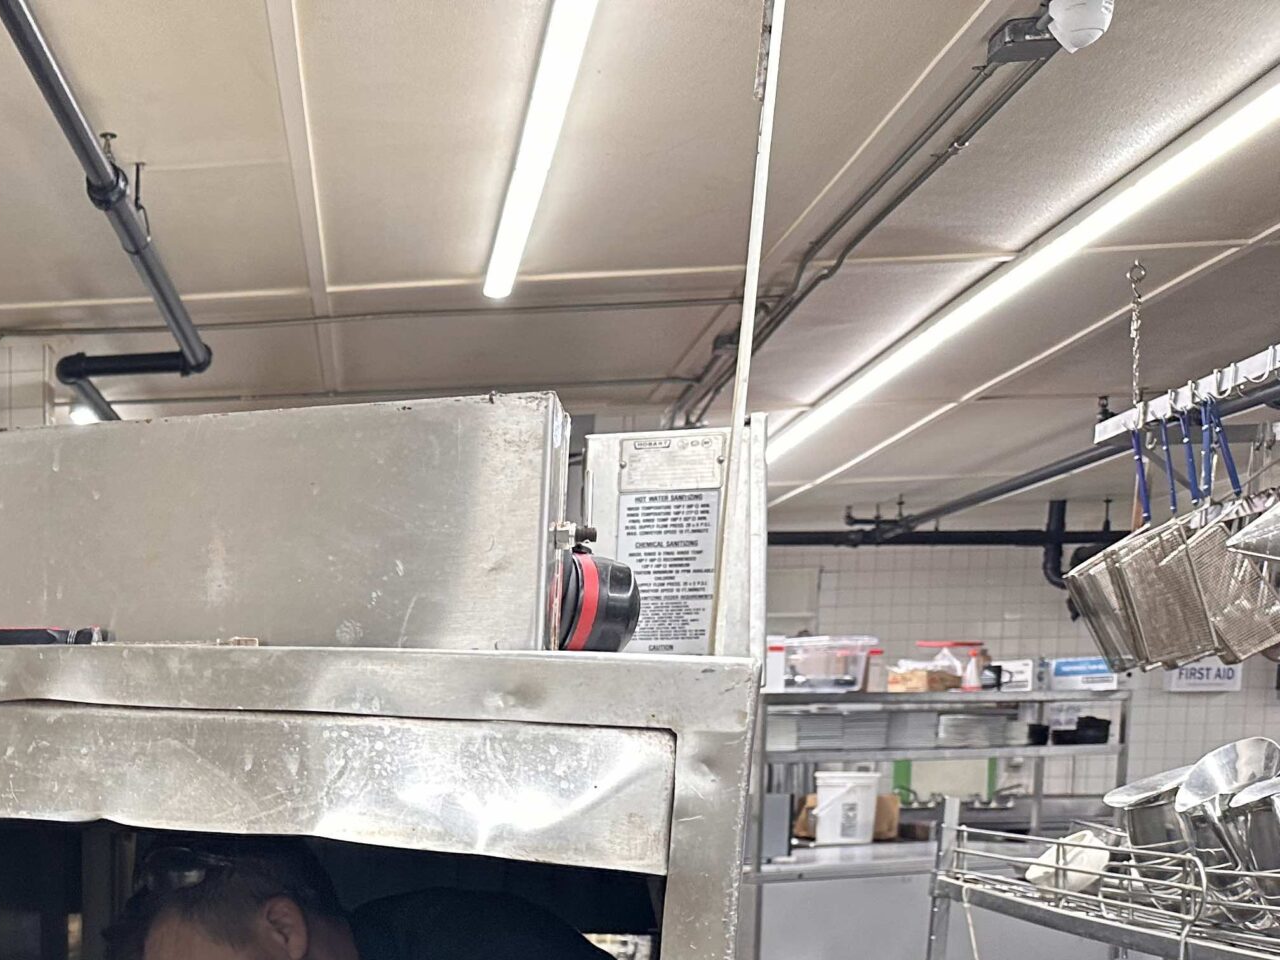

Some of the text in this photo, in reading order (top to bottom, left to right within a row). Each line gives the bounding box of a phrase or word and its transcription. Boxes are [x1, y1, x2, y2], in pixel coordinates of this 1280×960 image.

[635, 540, 698, 549] CHEMICAL SANITIZING
[1178, 667, 1235, 681] FIRST AID
